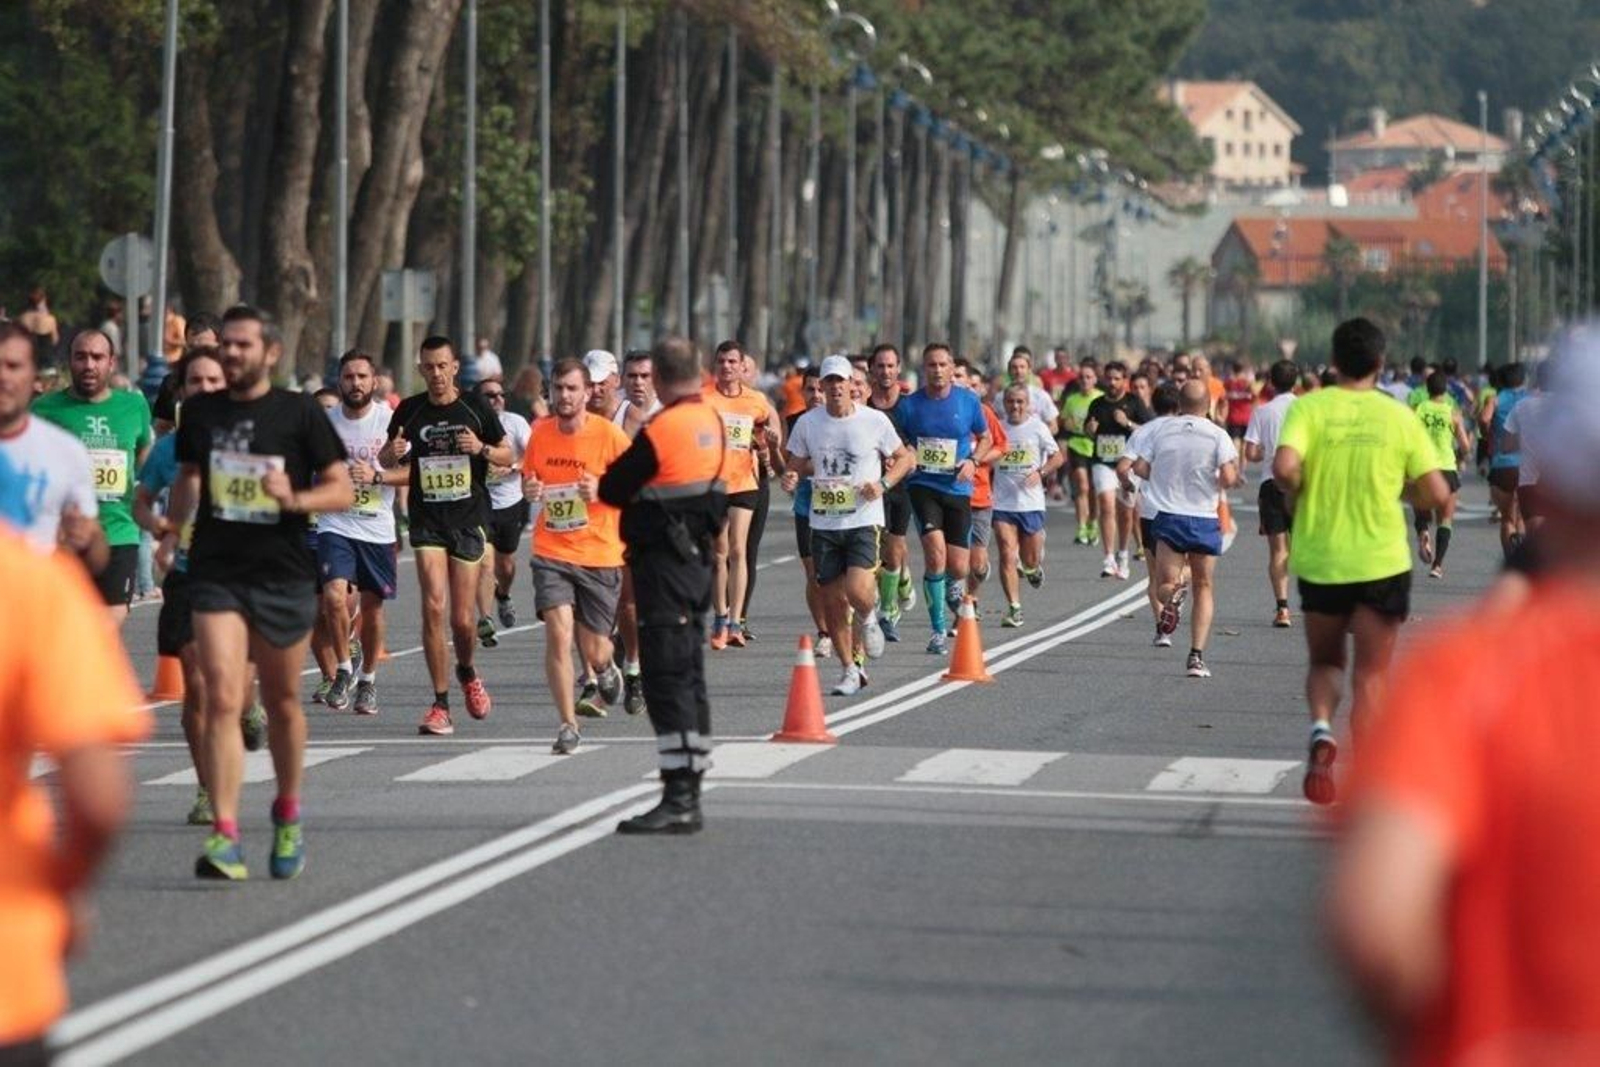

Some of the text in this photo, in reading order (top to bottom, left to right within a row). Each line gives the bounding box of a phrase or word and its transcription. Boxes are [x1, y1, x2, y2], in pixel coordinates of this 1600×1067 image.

[86, 416, 110, 435] 36
[922, 449, 948, 463] 862
[1003, 450, 1026, 462] 297
[95, 468, 118, 486] 30
[426, 473, 465, 489] 1138
[227, 477, 257, 501] 48
[820, 491, 846, 505] 998
